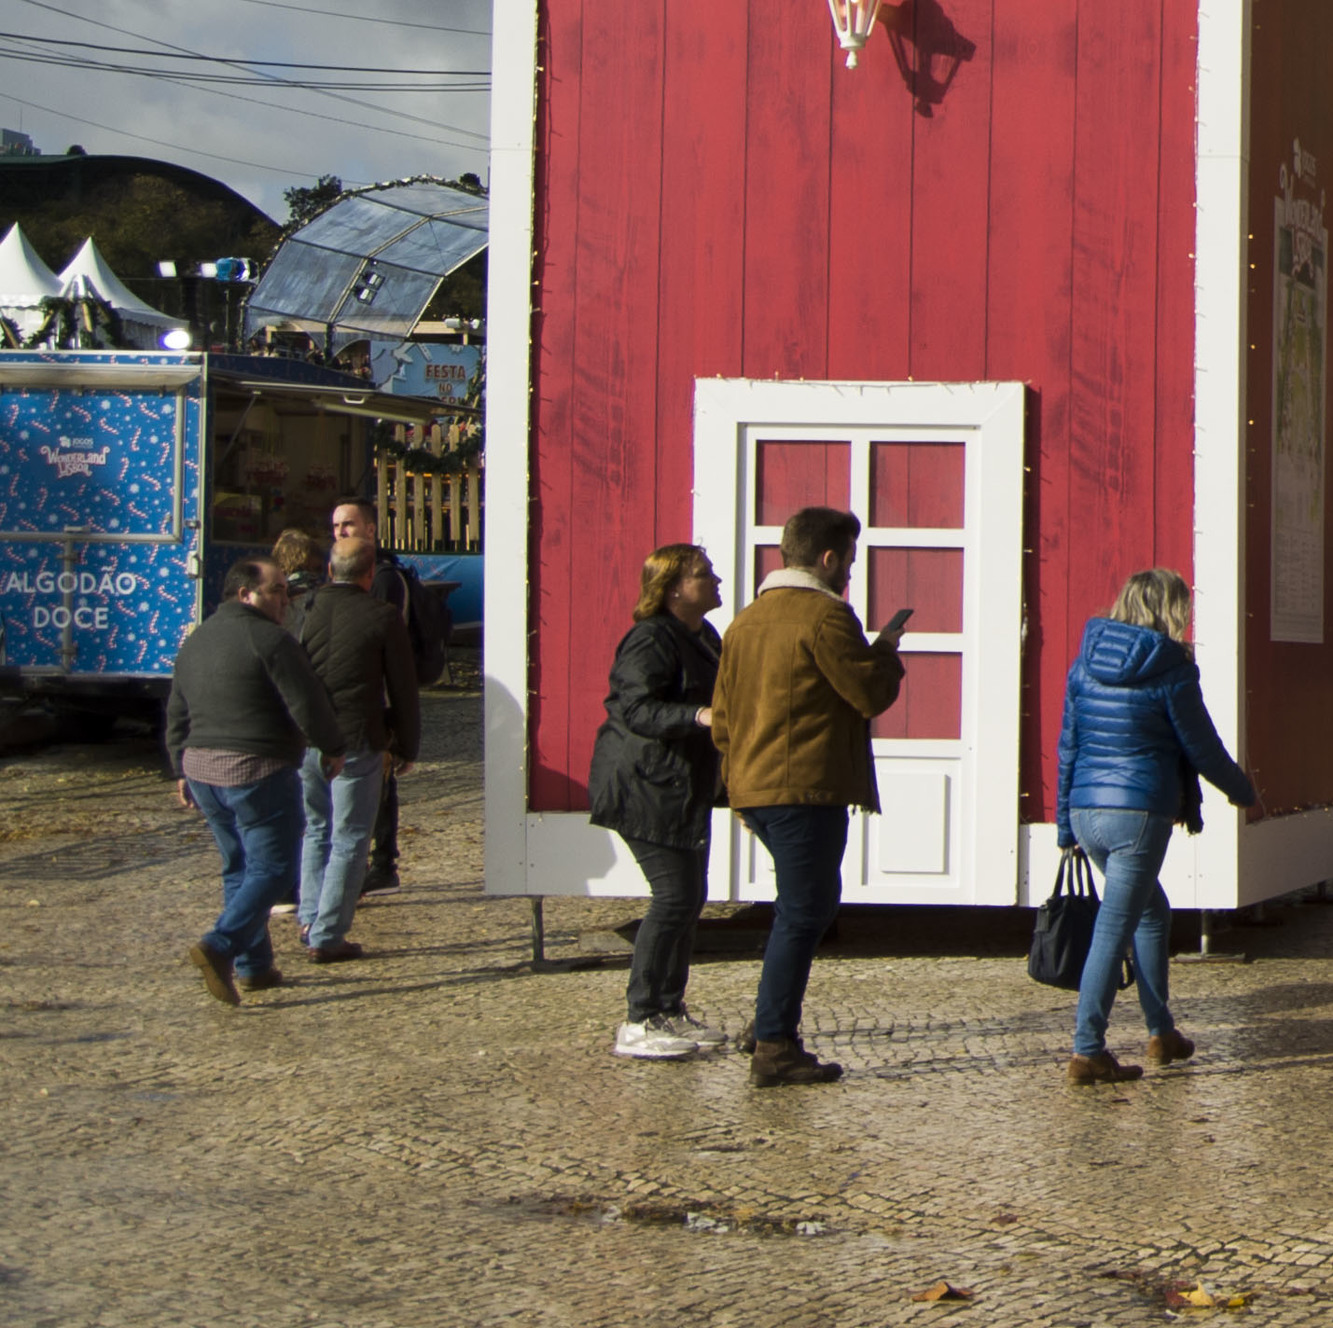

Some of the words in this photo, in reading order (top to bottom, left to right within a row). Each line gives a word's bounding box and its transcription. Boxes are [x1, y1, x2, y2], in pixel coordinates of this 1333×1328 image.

[425, 364, 466, 379] FESTA
[5, 565, 137, 595] ALGODÃO
[33, 606, 109, 629] DOCE
